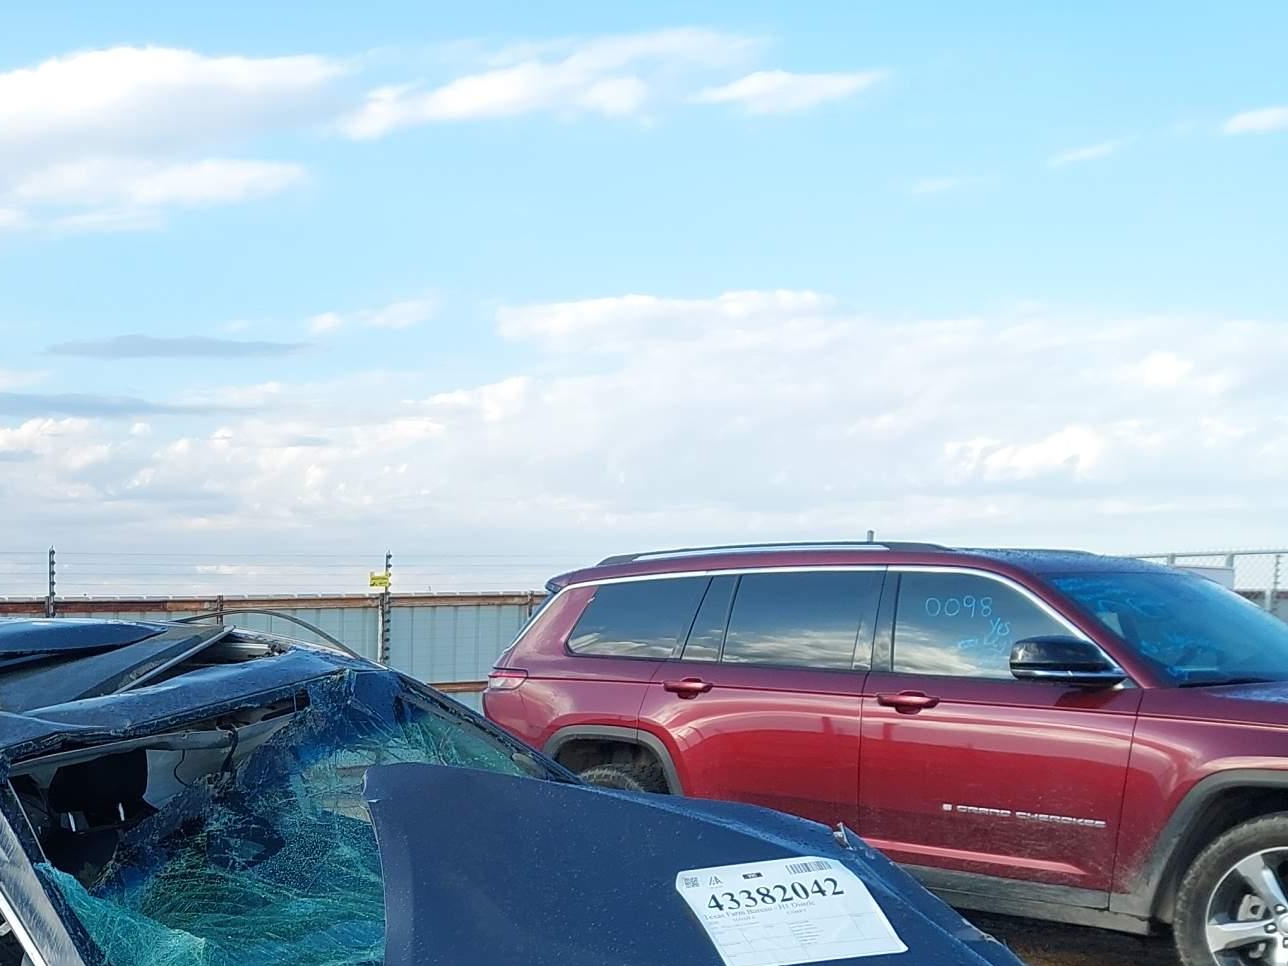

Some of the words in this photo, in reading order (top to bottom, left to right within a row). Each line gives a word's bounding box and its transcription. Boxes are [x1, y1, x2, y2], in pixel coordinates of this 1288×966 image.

[925, 595, 992, 617] 0098
[956, 804, 1011, 817] GRAND
[1015, 811, 1106, 828] CHEROKEE
[707, 877, 845, 912] 43382042
